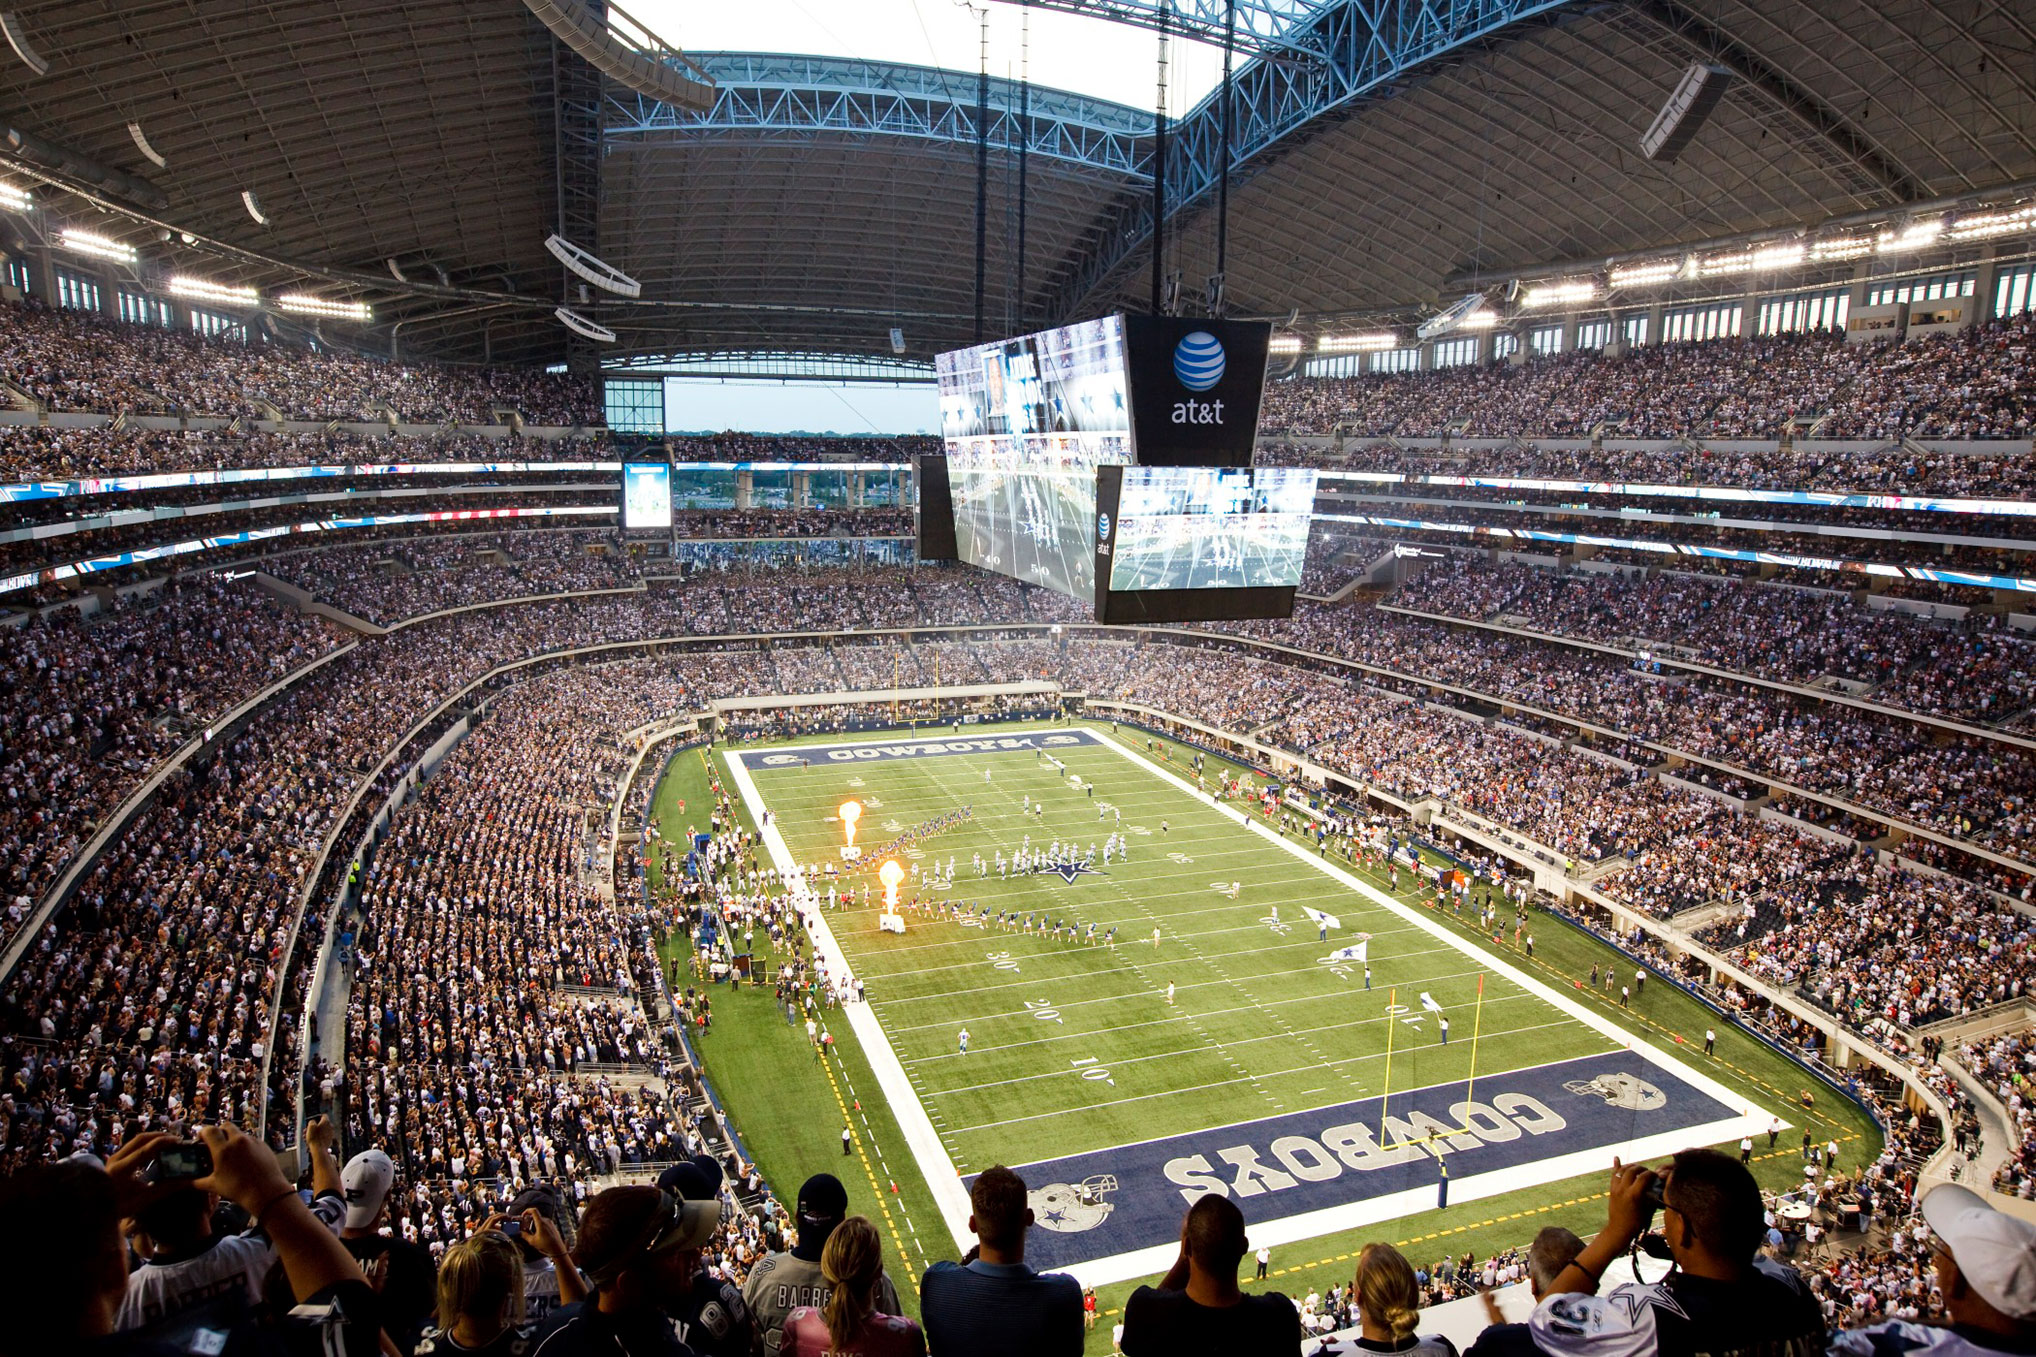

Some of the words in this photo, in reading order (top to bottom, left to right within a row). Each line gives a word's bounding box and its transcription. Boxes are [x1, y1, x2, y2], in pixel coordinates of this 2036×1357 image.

[1171, 398, 1225, 425] at&t
[1030, 563, 1050, 576] 50
[828, 738, 1029, 761] COWBOYS
[986, 951, 1017, 968] 30
[1024, 999, 1060, 1019] 20
[1070, 1056, 1110, 1080] 10
[1163, 1093, 1567, 1206] COWBOYS
[777, 1284, 833, 1308] BARBE
